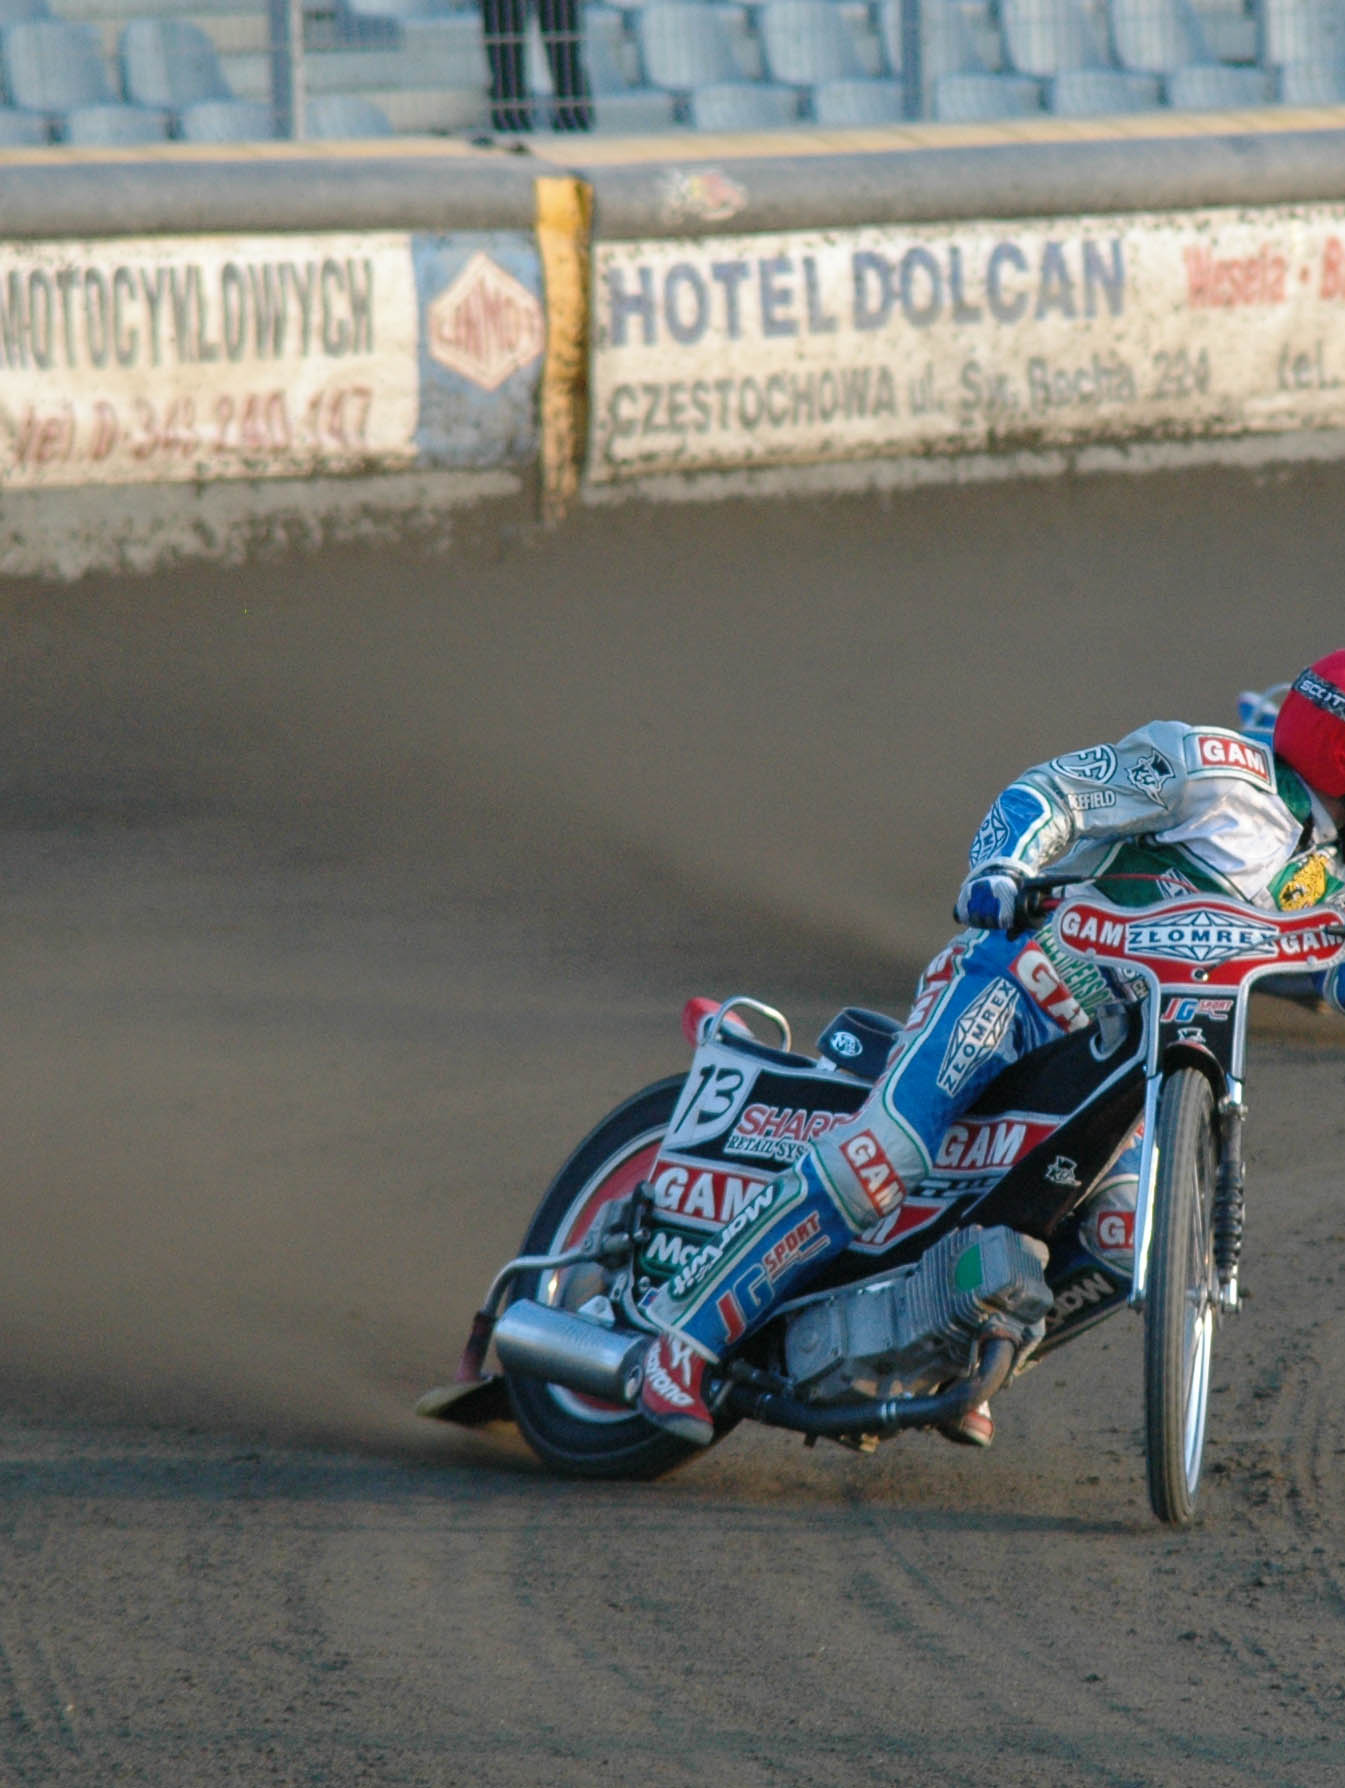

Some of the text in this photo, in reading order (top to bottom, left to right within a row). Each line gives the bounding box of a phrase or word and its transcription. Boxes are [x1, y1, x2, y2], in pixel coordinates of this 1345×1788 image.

[608, 258, 837, 347] HOTEL
[851, 238, 1127, 331] DOLCAN
[1202, 737, 1267, 777] GAM
[1061, 912, 1124, 948] GAM
[1129, 929, 1278, 945] ZŁOMREX
[1280, 921, 1345, 954] GAM
[944, 980, 1017, 1090] ZŁOMREX
[672, 1063, 744, 1134] 13
[936, 1123, 1027, 1169] GAM
[656, 1167, 764, 1224] GAM
[848, 1136, 904, 1215] GAM
